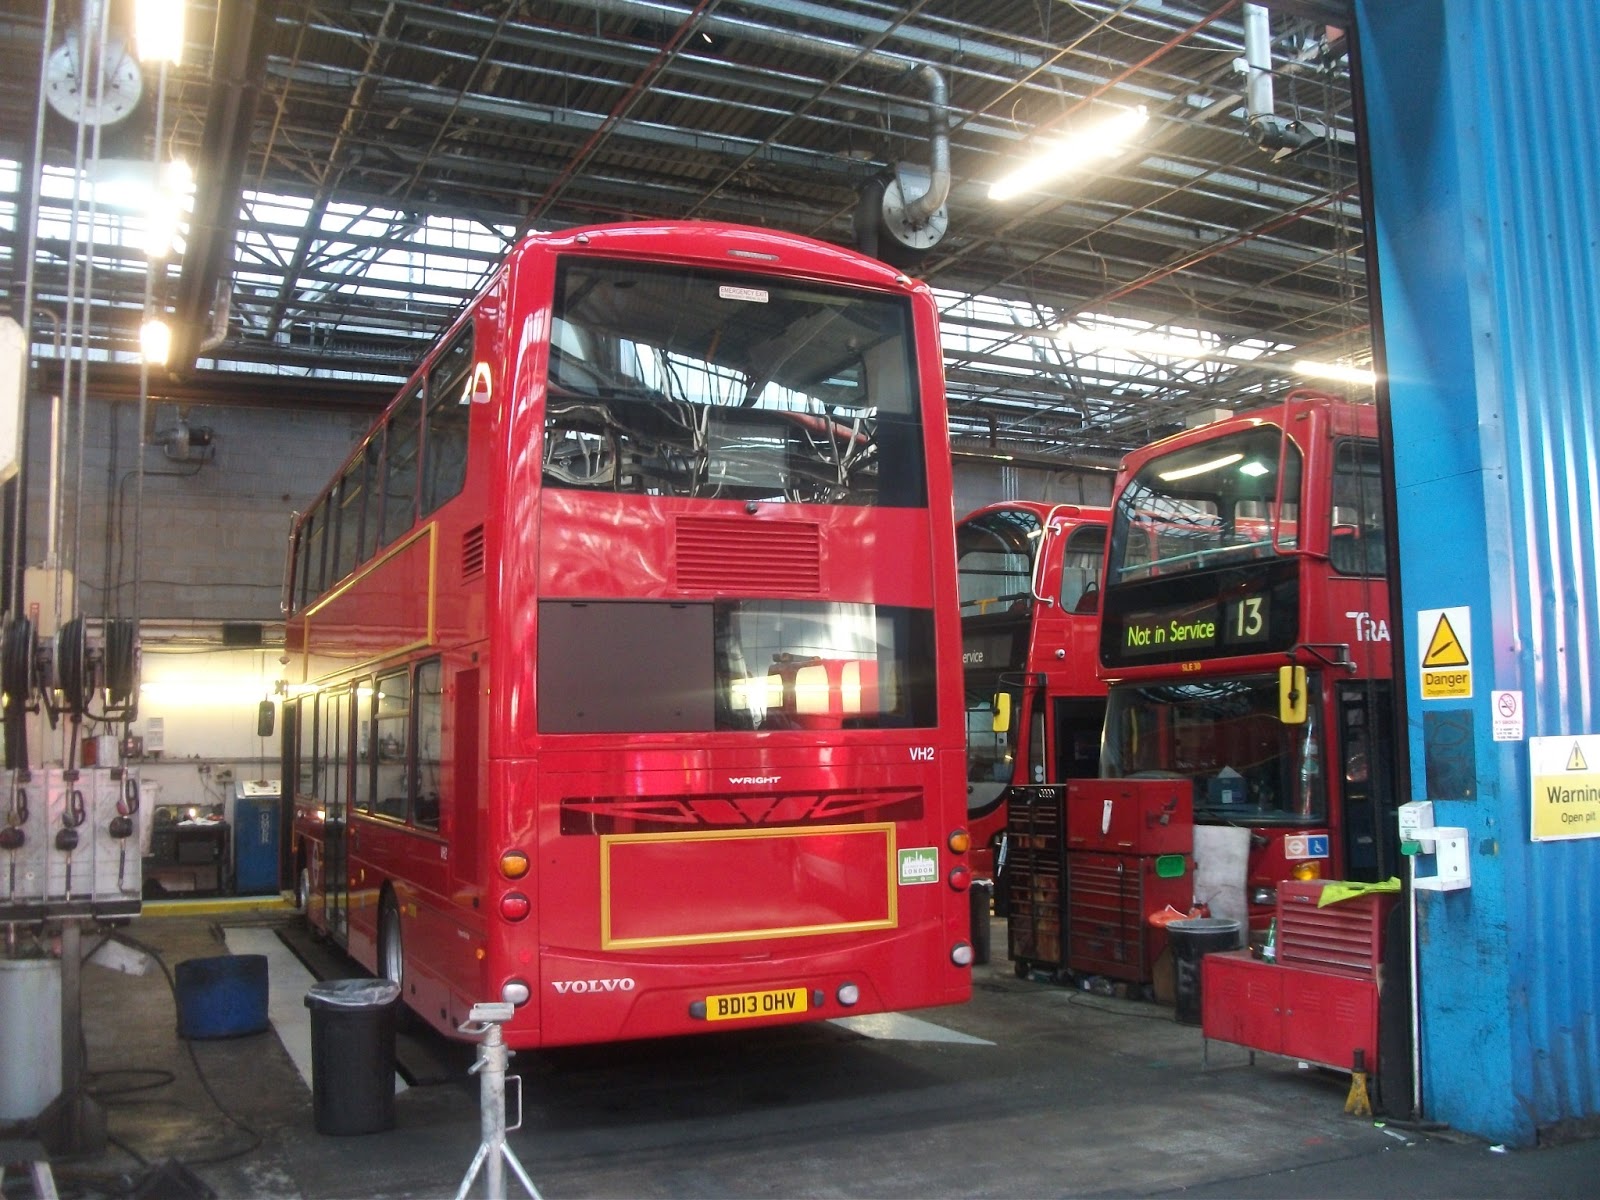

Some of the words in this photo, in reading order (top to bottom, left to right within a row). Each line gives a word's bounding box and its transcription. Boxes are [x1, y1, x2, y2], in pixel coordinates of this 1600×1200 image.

[721, 286, 754, 296] EMERGENCY
[755, 290, 767, 298] EXIT
[1237, 597, 1263, 637] 13
[1128, 626, 1151, 646] Not
[1155, 625, 1165, 643] in
[1169, 620, 1215, 642] Service
[1425, 673, 1467, 687] Danger
[909, 746, 935, 760] VH2
[728, 776, 781, 784] WRIGHT
[1561, 812, 1583, 824] Open
[1586, 811, 1596, 823] pit
[904, 867, 933, 875] LONDON
[552, 978, 635, 994] VOLVO
[718, 996, 757, 1016] BD13
[763, 992, 796, 1011] OHV
